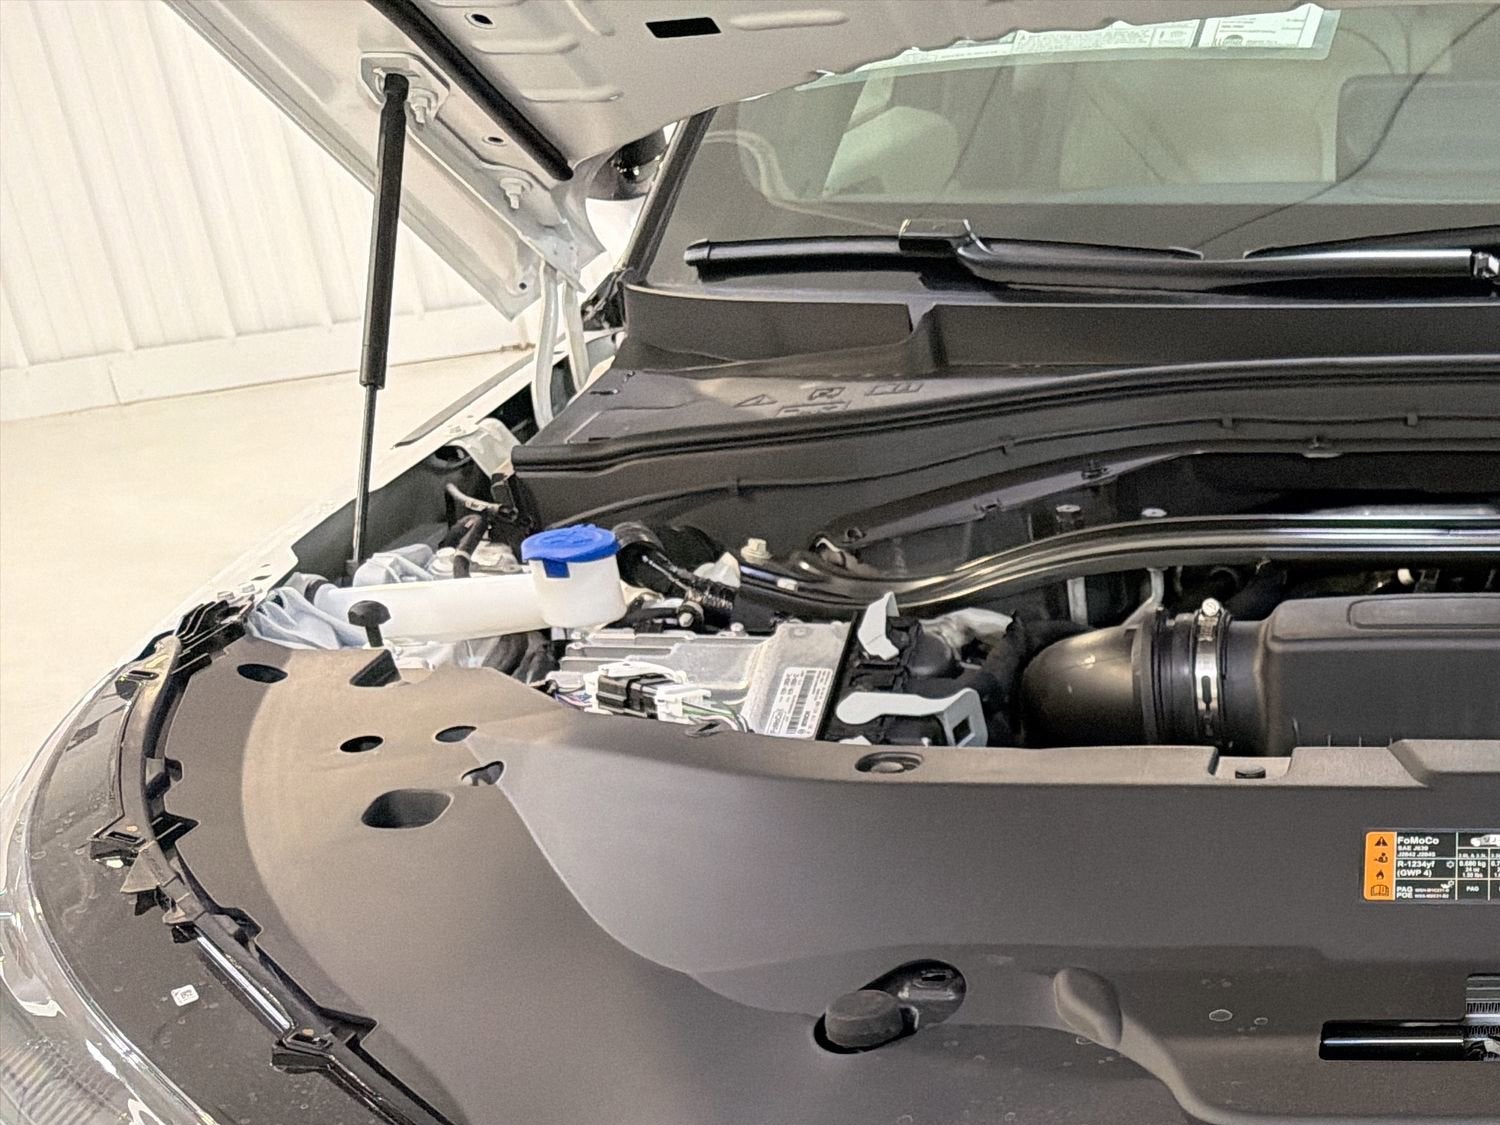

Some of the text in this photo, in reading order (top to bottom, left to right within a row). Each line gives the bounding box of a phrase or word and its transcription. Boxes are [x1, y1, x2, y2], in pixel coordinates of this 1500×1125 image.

[1397, 836, 1440, 845] FoMoCo
[1397, 860, 1436, 869] R-1234yf
[1397, 869, 1432, 877] (GWP 4)
